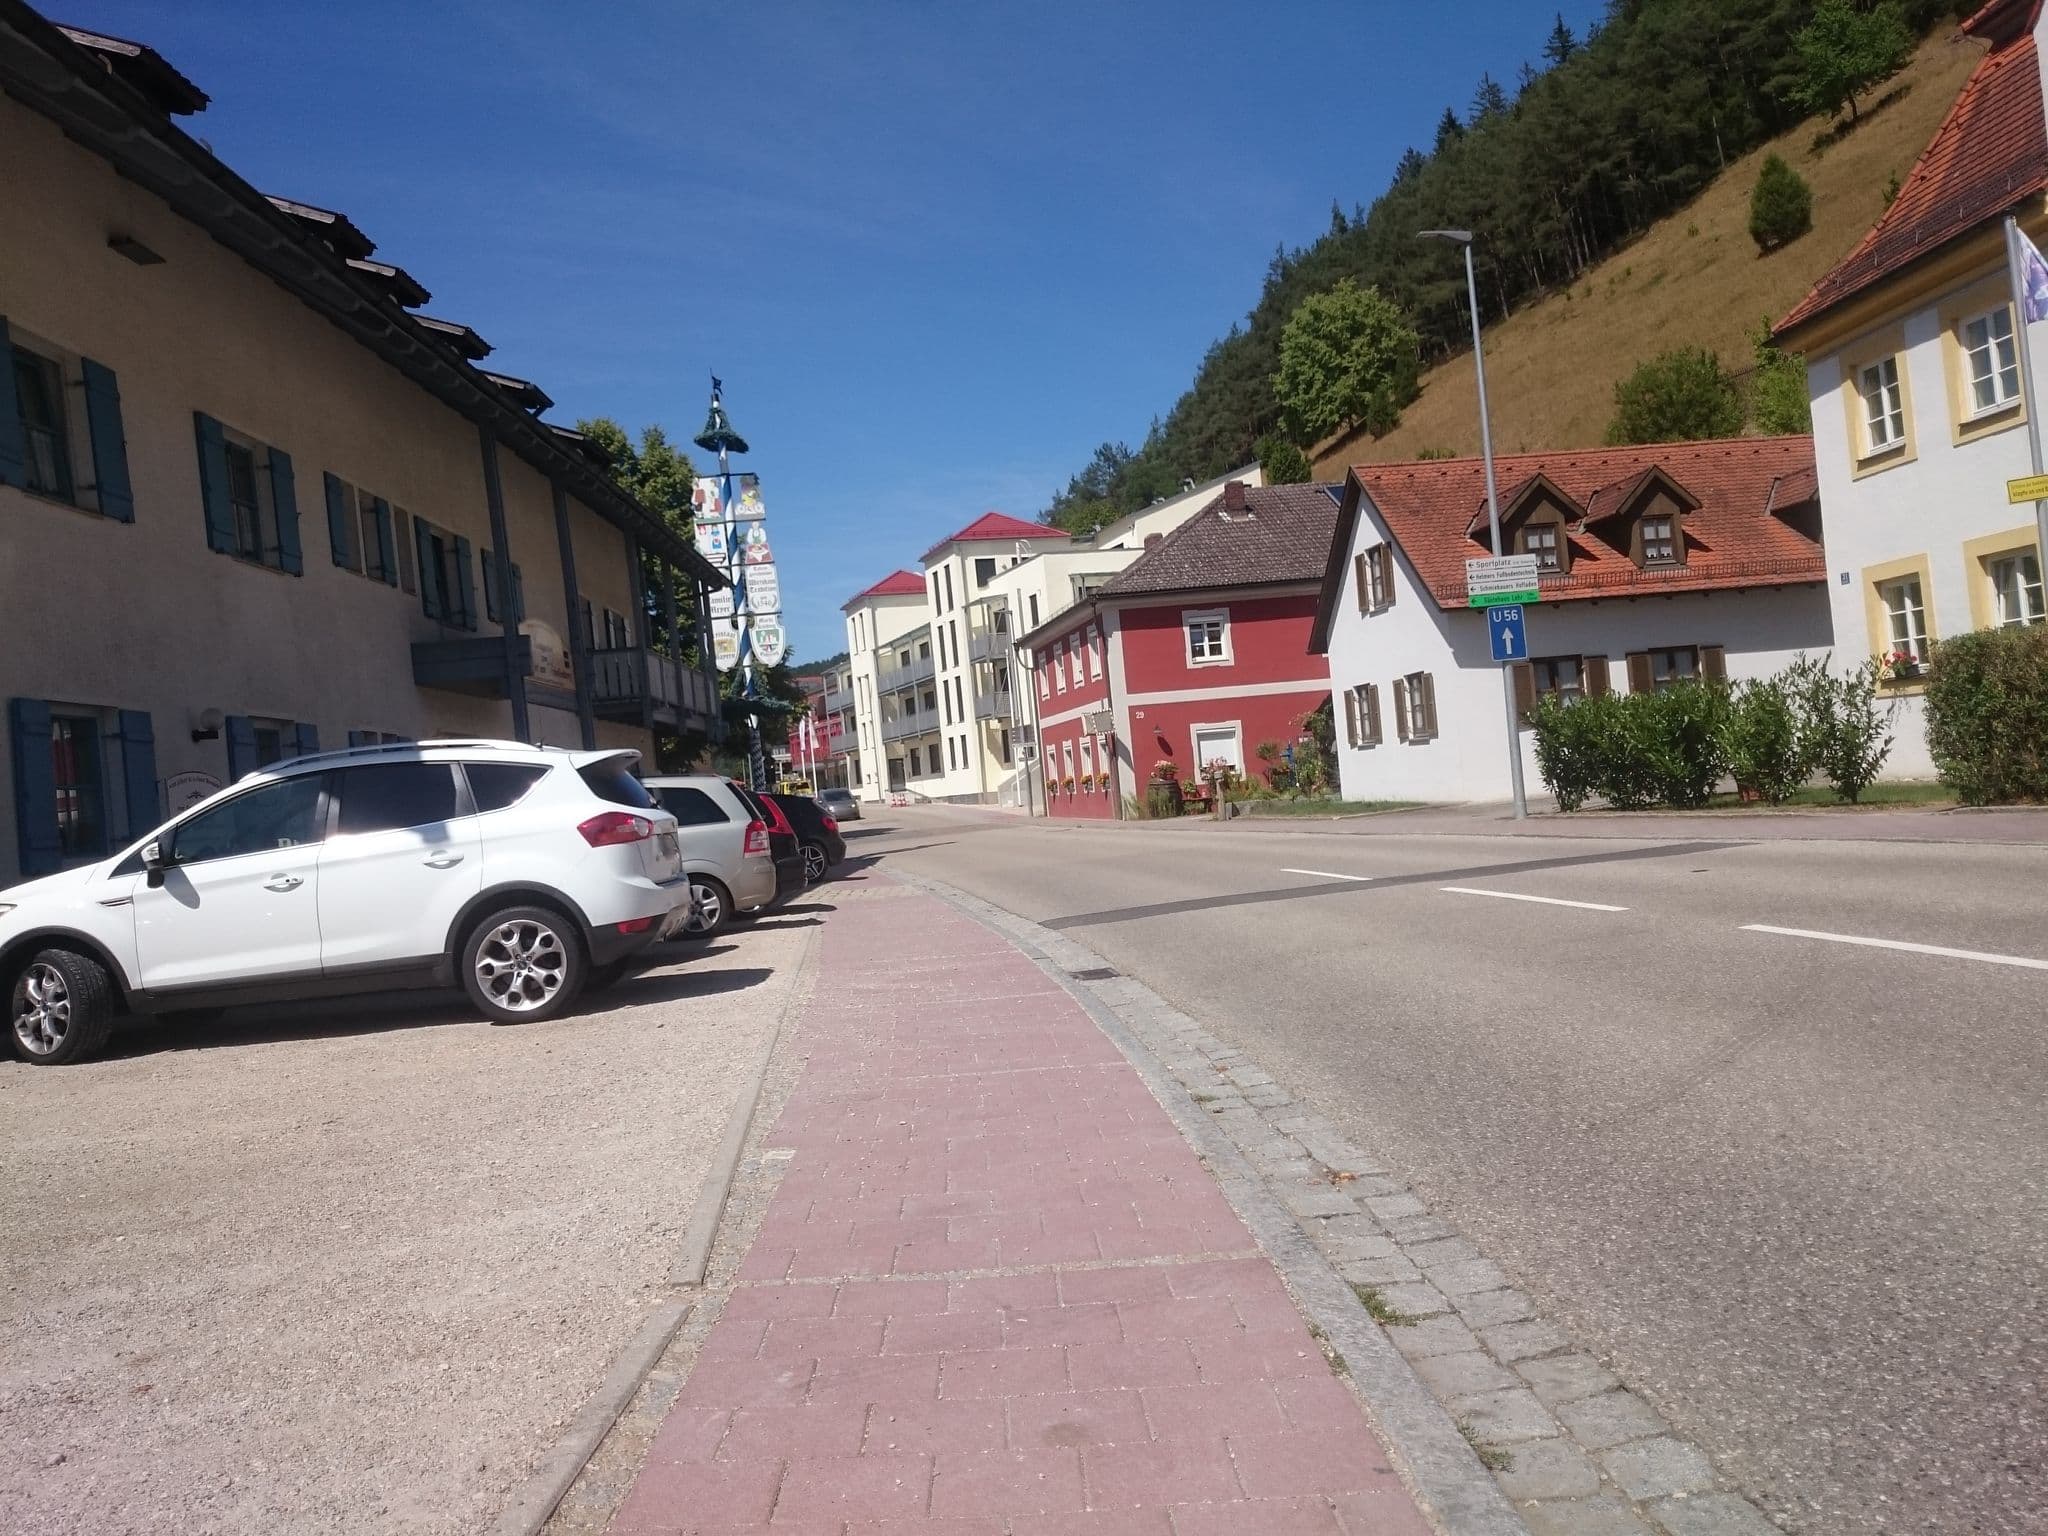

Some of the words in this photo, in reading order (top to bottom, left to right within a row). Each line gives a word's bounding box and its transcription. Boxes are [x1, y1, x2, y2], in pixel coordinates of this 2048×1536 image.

[1476, 559, 1511, 569] Sportplatz
[711, 596, 731, 605] amilie
[1493, 611, 1502, 622] U
[1503, 609, 1519, 622] 56
[1136, 711, 1145, 719] 29
